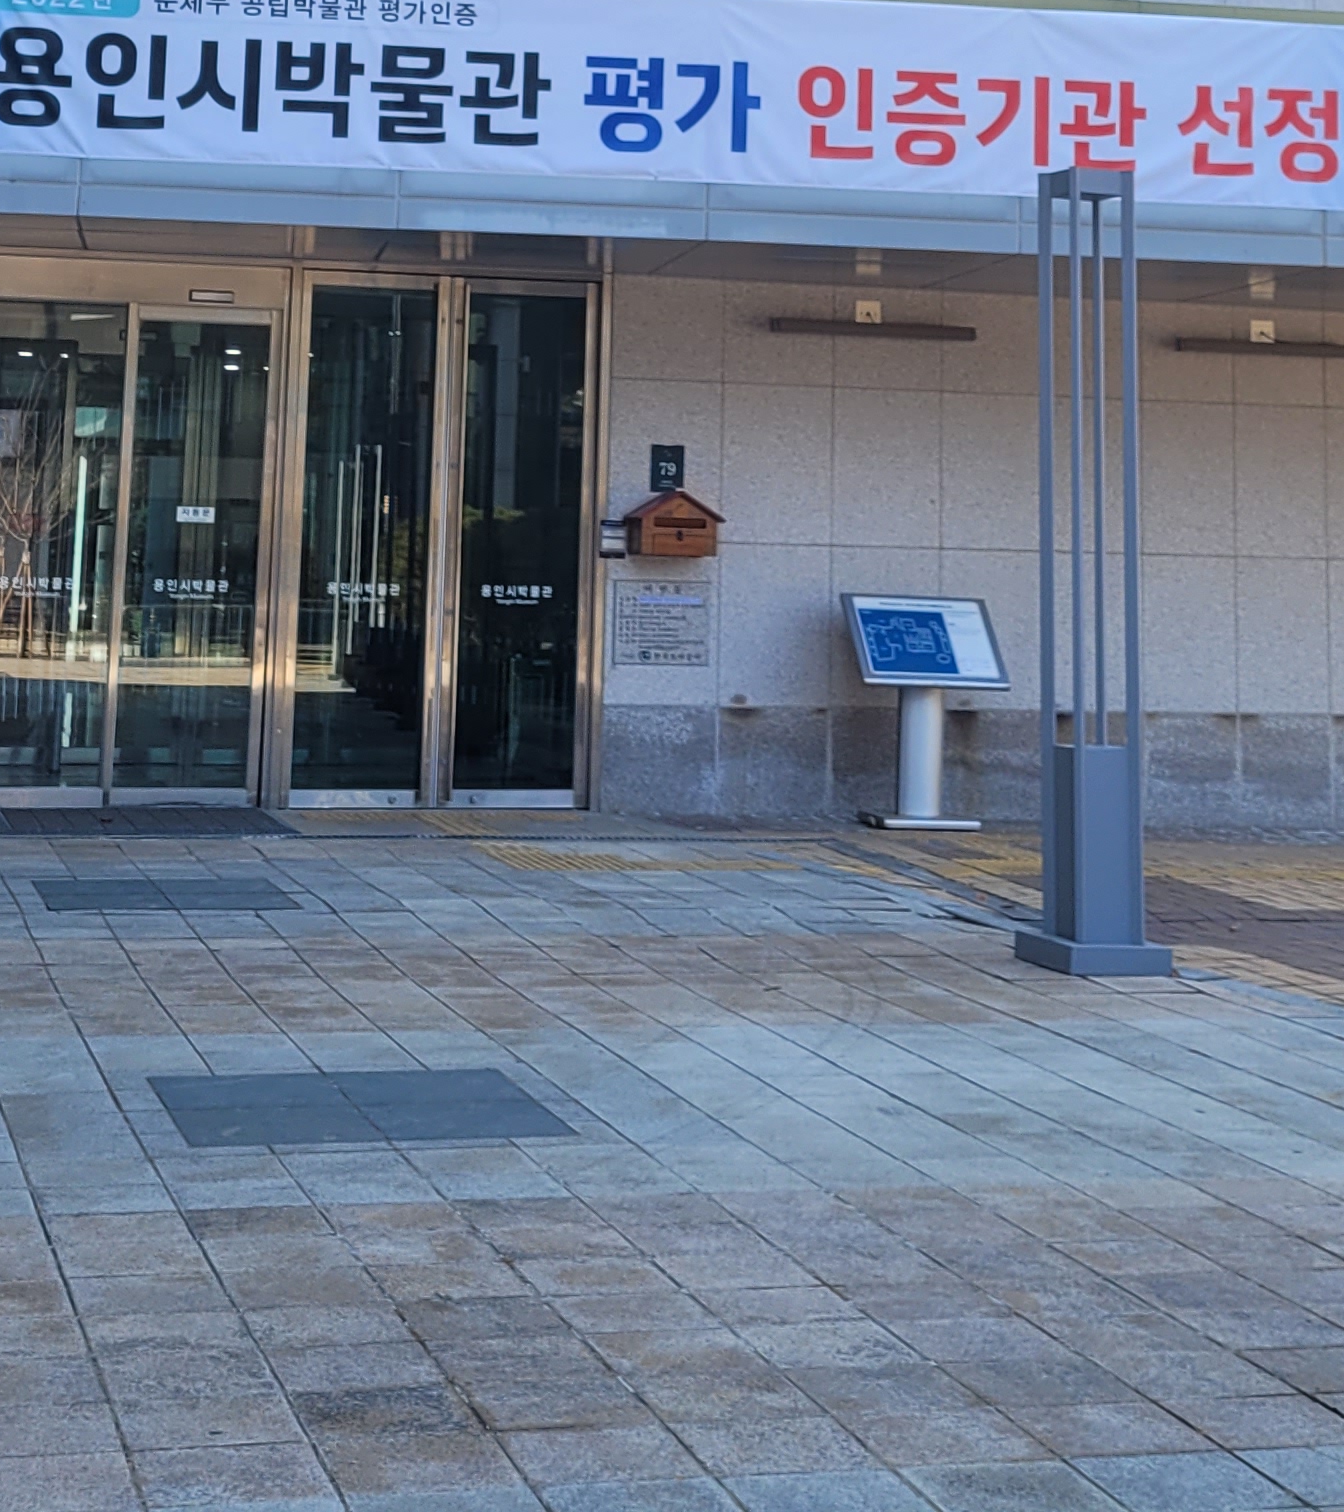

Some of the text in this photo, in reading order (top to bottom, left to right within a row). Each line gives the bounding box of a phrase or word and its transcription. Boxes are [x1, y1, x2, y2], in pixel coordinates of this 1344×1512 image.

[377, 0, 479, 27] 평가인증
[583, 55, 761, 155] 평가
[796, 63, 1147, 171] 인증기관
[1176, 85, 1340, 183] 선정
[658, 461, 677, 476] 79
[152, 578, 229, 593] 용인시박물관
[481, 584, 553, 598] 용인시박물관
